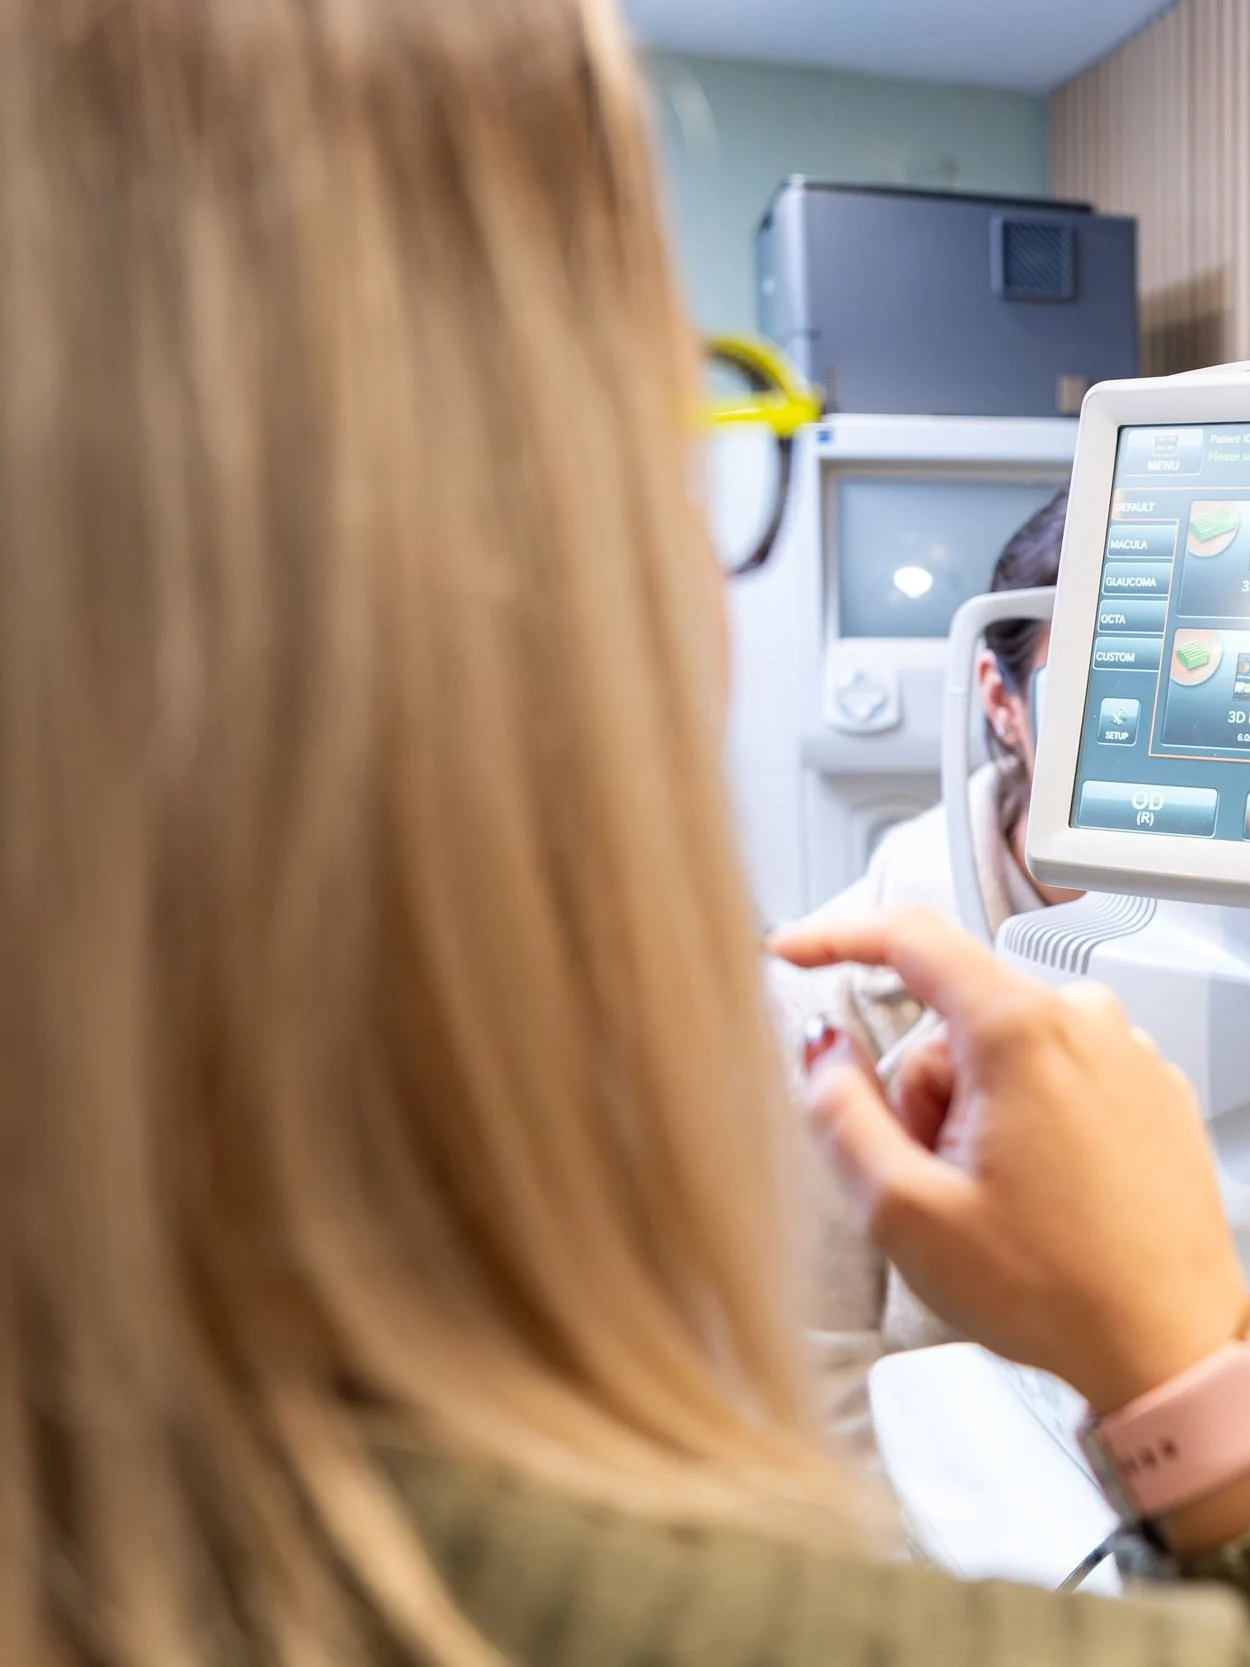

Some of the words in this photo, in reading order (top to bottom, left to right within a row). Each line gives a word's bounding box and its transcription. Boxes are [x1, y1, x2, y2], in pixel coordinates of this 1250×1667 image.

[1210, 434, 1241, 444] Patient
[1208, 451, 1240, 462] Please
[1148, 460, 1180, 471] MENU
[1114, 502, 1156, 512] DEFAULT
[1110, 540, 1148, 550] MACULA
[1105, 576, 1156, 588] GLAUCOMA
[1100, 614, 1126, 624] OCTA
[1096, 651, 1135, 663] CUSTOM
[1227, 711, 1246, 724] 3D
[1105, 731, 1129, 740] SETUP
[1131, 791, 1165, 812] OD
[1136, 811, 1155, 826] (R)
